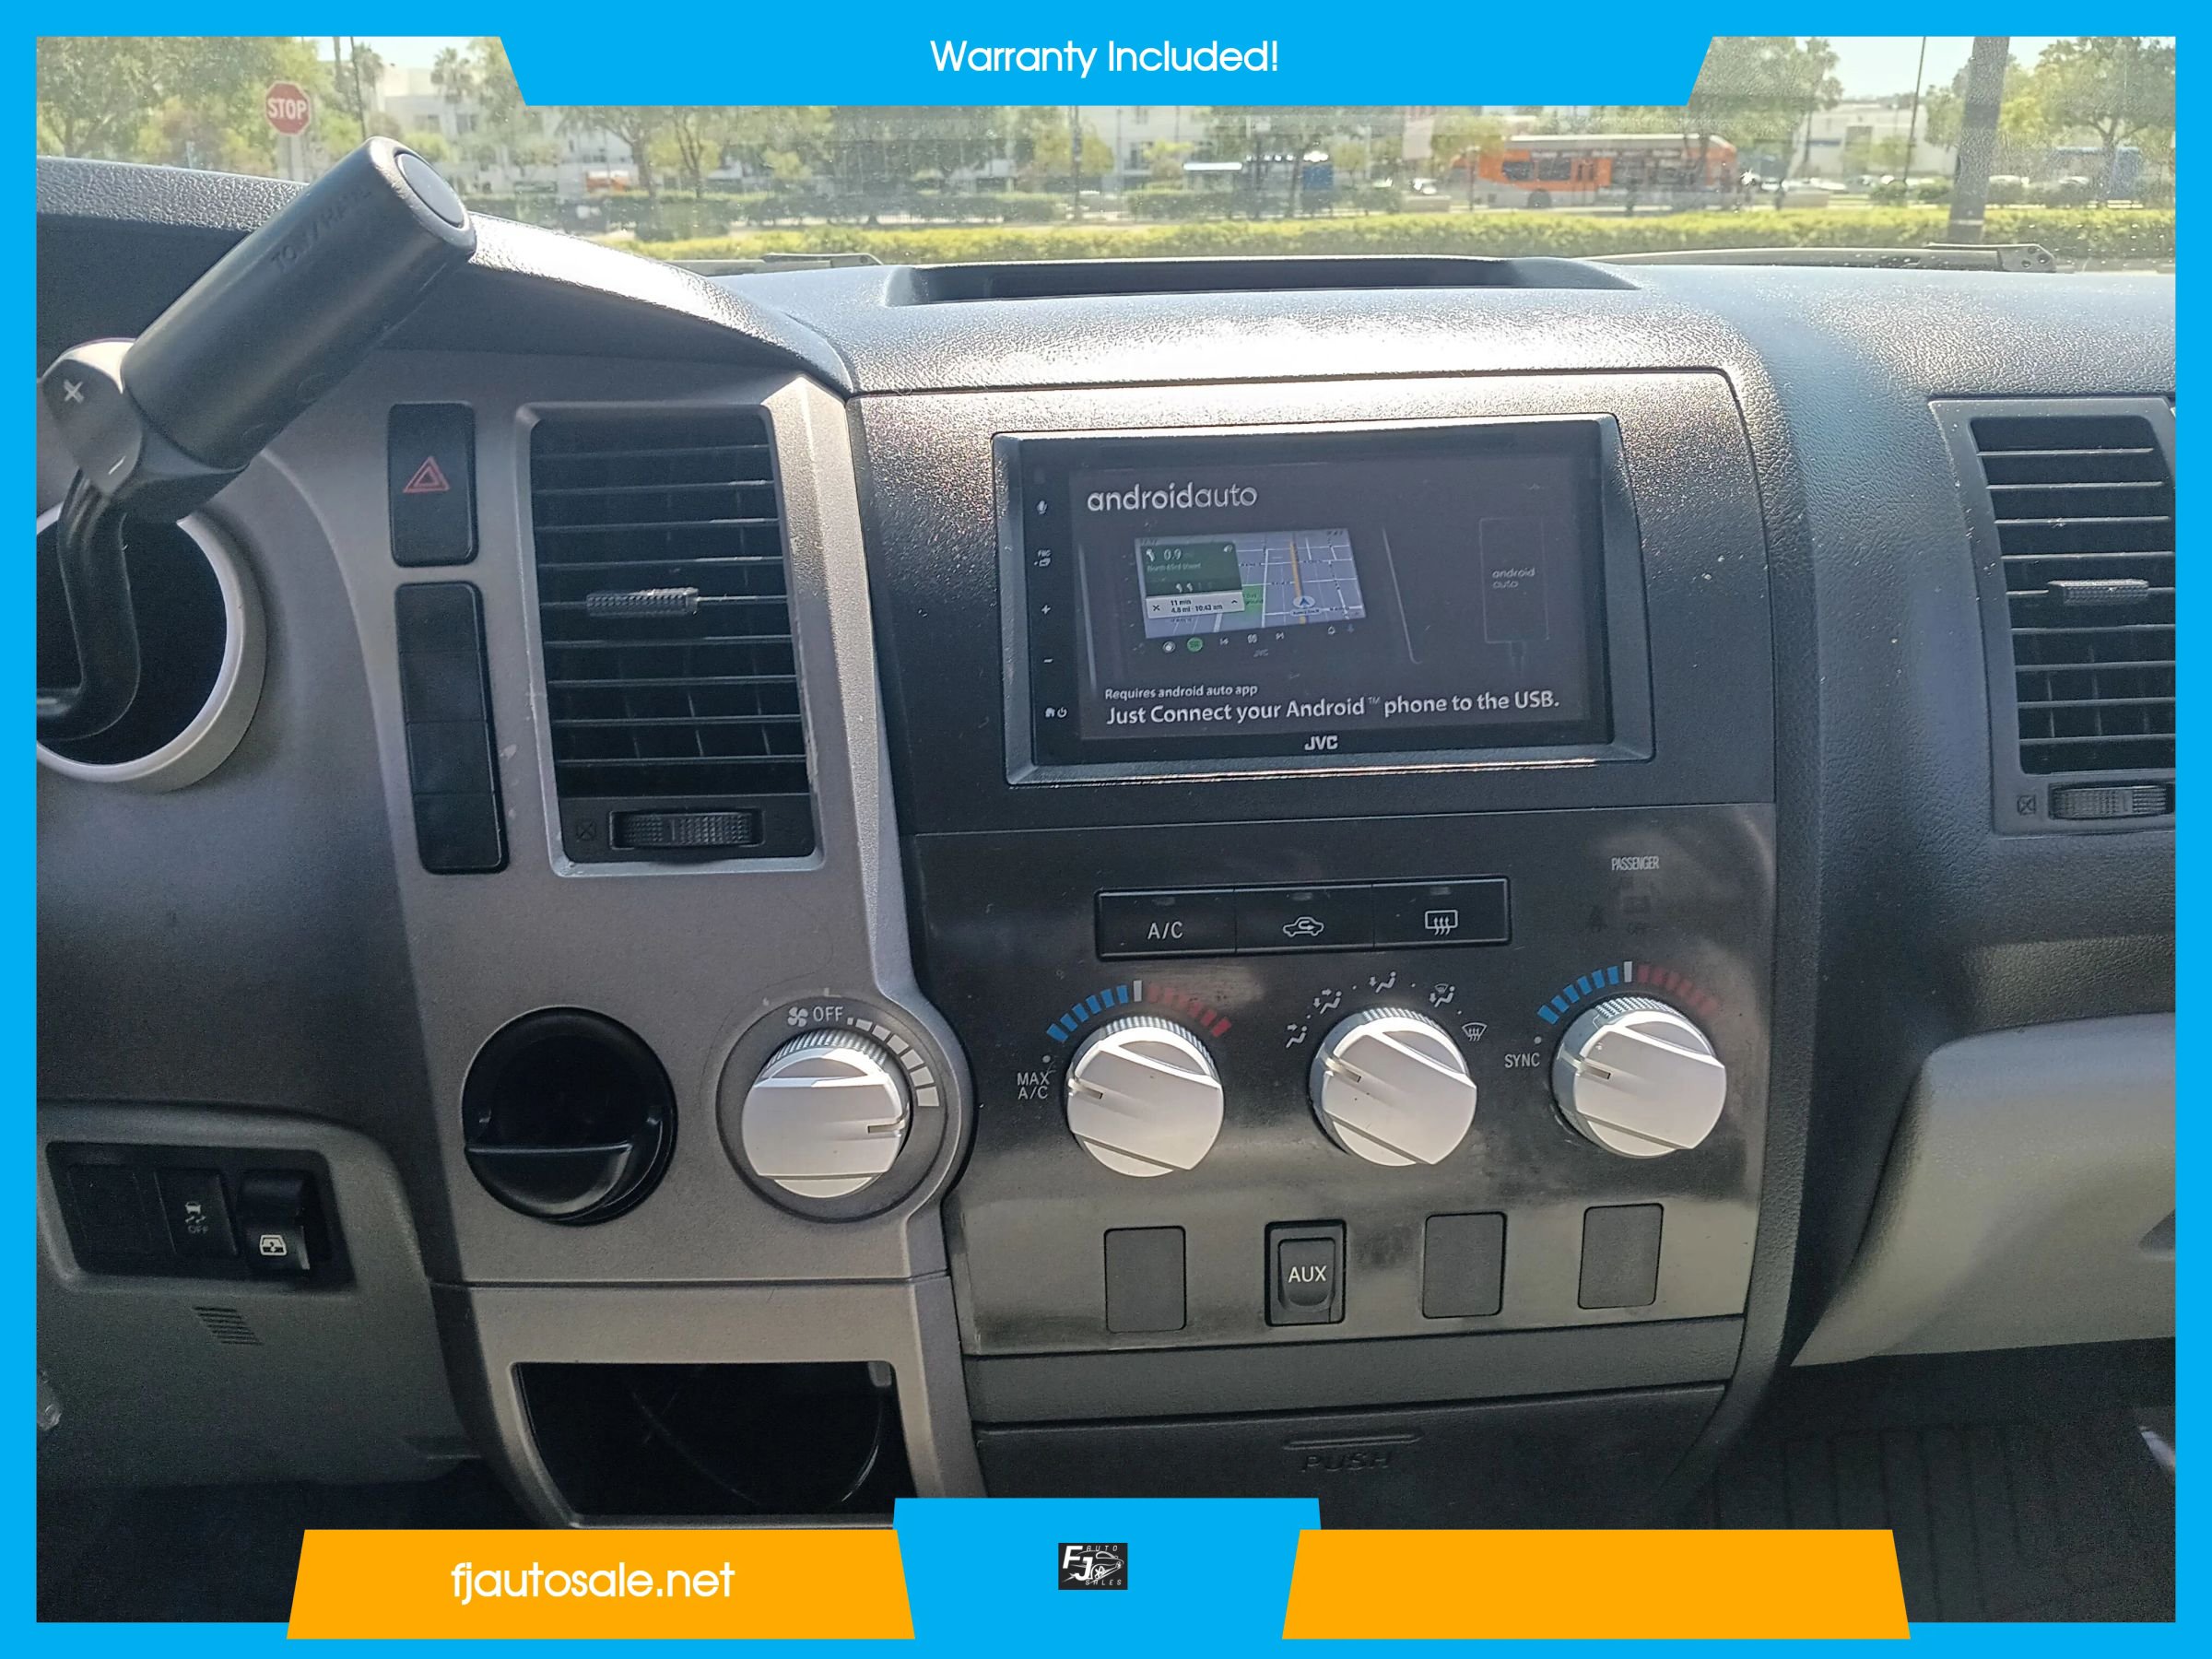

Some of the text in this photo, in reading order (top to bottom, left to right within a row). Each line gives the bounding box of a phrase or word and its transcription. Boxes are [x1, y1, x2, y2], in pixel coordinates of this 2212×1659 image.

[267, 97, 307, 120] STOP
[1491, 566, 1535, 579] android
[1492, 580, 1519, 590] auto
[1105, 685, 1258, 701] Requires android auto app
[1106, 706, 1147, 725] Just
[1150, 704, 1232, 724] Connect
[1236, 703, 1282, 724] your
[1384, 695, 1447, 718] phone
[1452, 695, 1473, 712] to
[1477, 691, 1510, 711] the
[1514, 690, 1560, 710] USB.
[1304, 735, 1338, 751] JVC
[1610, 854, 1660, 872] PASSENGER
[1147, 921, 1183, 940] A/C
[813, 1006, 844, 1022] OFF
[1504, 1052, 1540, 1068] SYNC
[1017, 1071, 1051, 1086] MAX
[1018, 1086, 1049, 1100] A/C
[1288, 1265, 1327, 1283] AUX
[1300, 1452, 1391, 1473] PUSH
